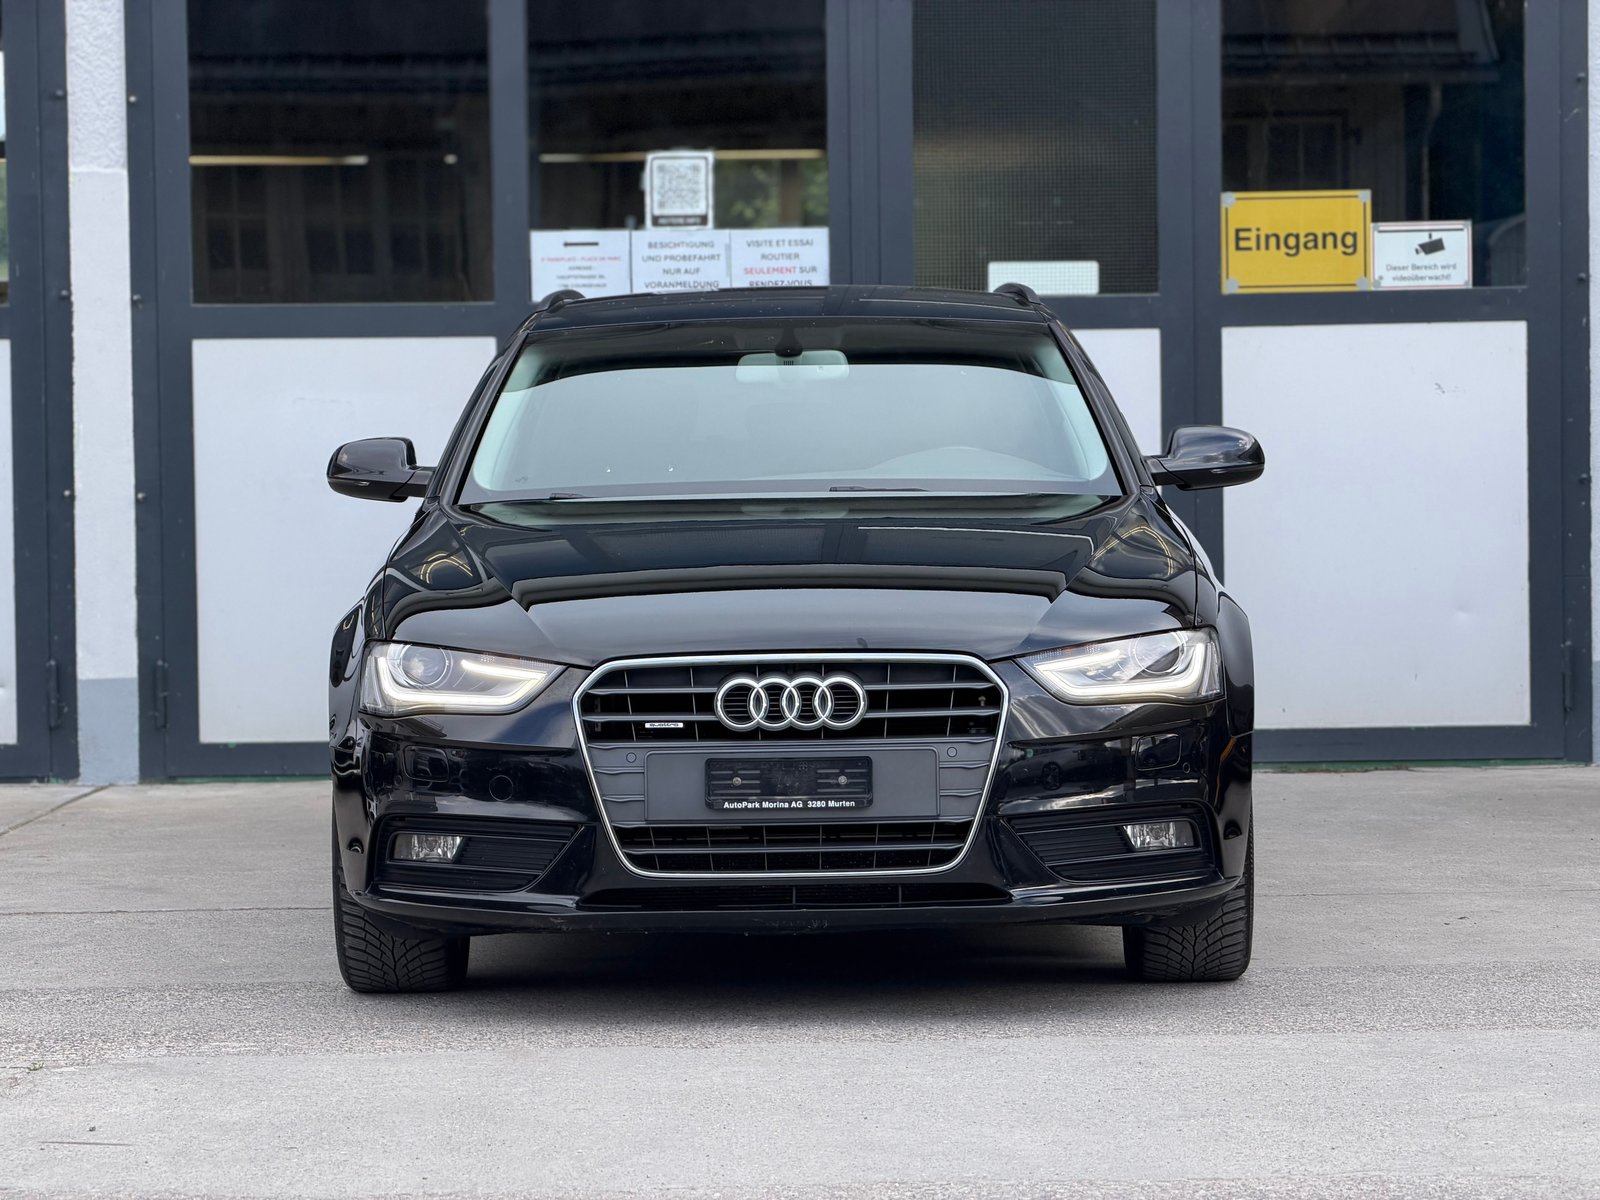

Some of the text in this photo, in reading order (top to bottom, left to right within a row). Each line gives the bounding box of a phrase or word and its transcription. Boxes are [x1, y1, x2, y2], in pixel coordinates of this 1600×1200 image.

[647, 241, 714, 249] BESICHTIGUNG
[746, 238, 814, 248] VISITE ET ESSAI
[1234, 227, 1358, 257] Eingang
[641, 254, 721, 262] UND PROBEFAHRT
[662, 267, 700, 275] NUR AUF
[743, 266, 818, 275] SEULEMENT SUR
[1411, 263, 1439, 271] Bereich
[644, 281, 719, 289] VORANMELDUNG
[723, 801, 760, 809] AutoPark
[807, 800, 826, 808] 3280
